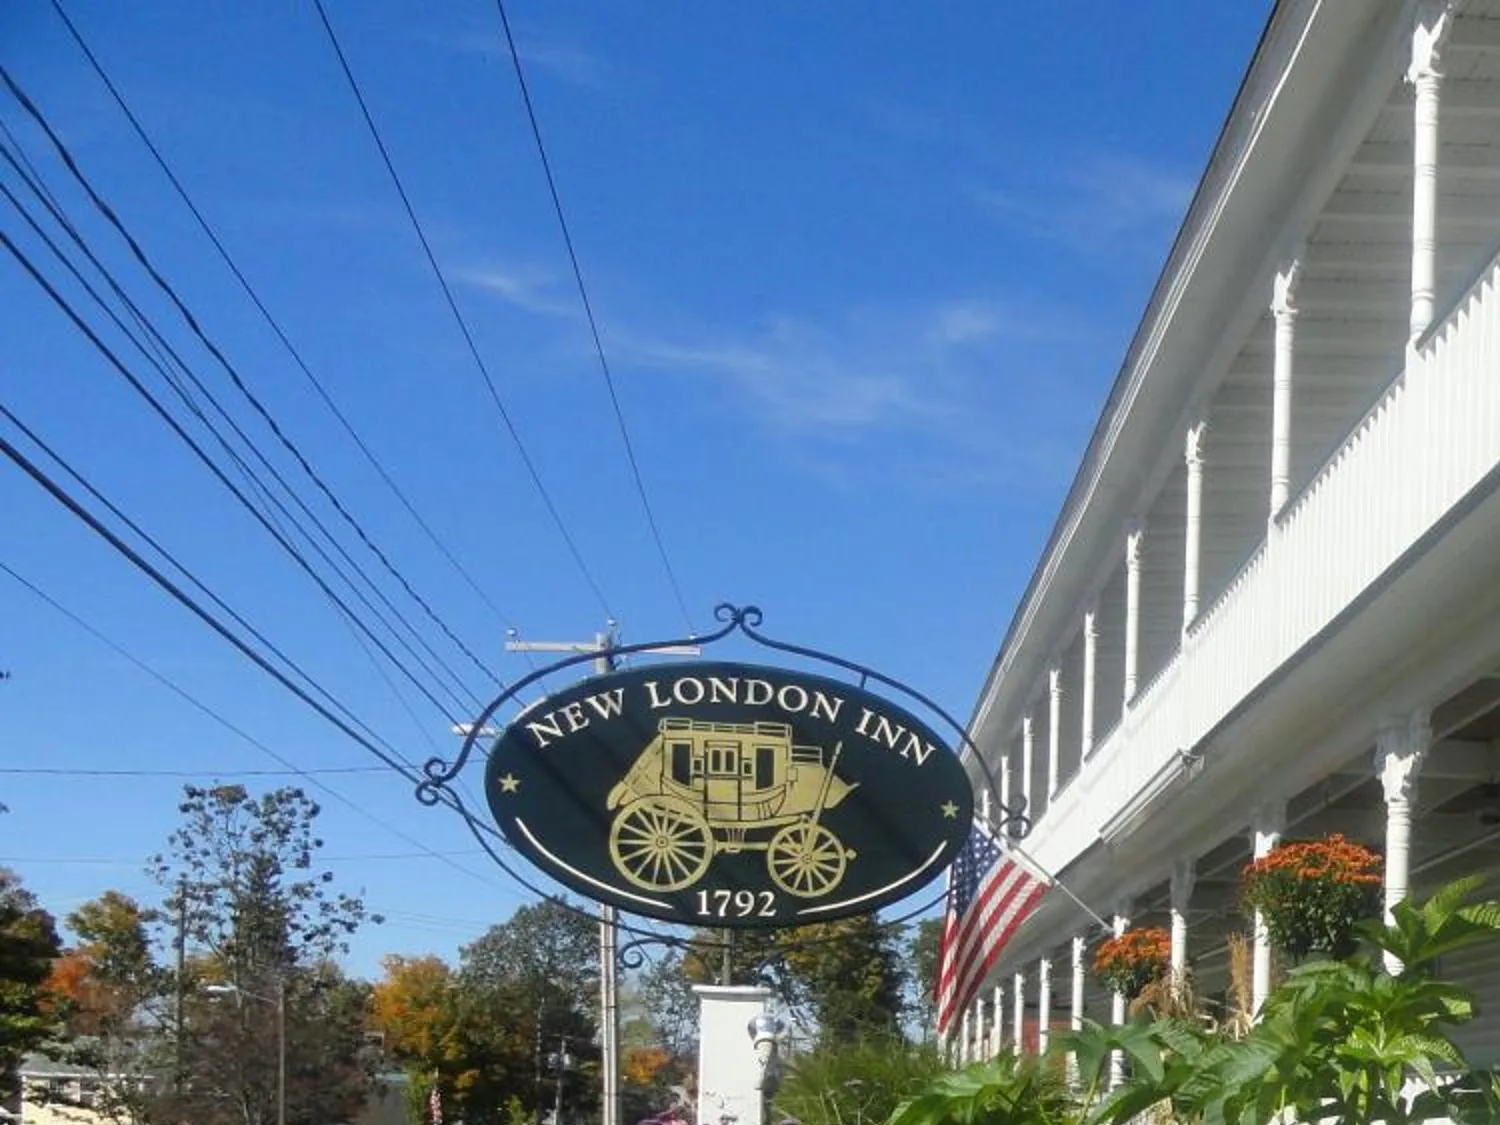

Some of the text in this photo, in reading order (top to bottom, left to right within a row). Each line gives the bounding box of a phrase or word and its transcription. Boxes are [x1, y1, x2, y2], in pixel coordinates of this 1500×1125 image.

[524, 676, 937, 767] NEW LONDON INN
[696, 889, 777, 917] 1792
